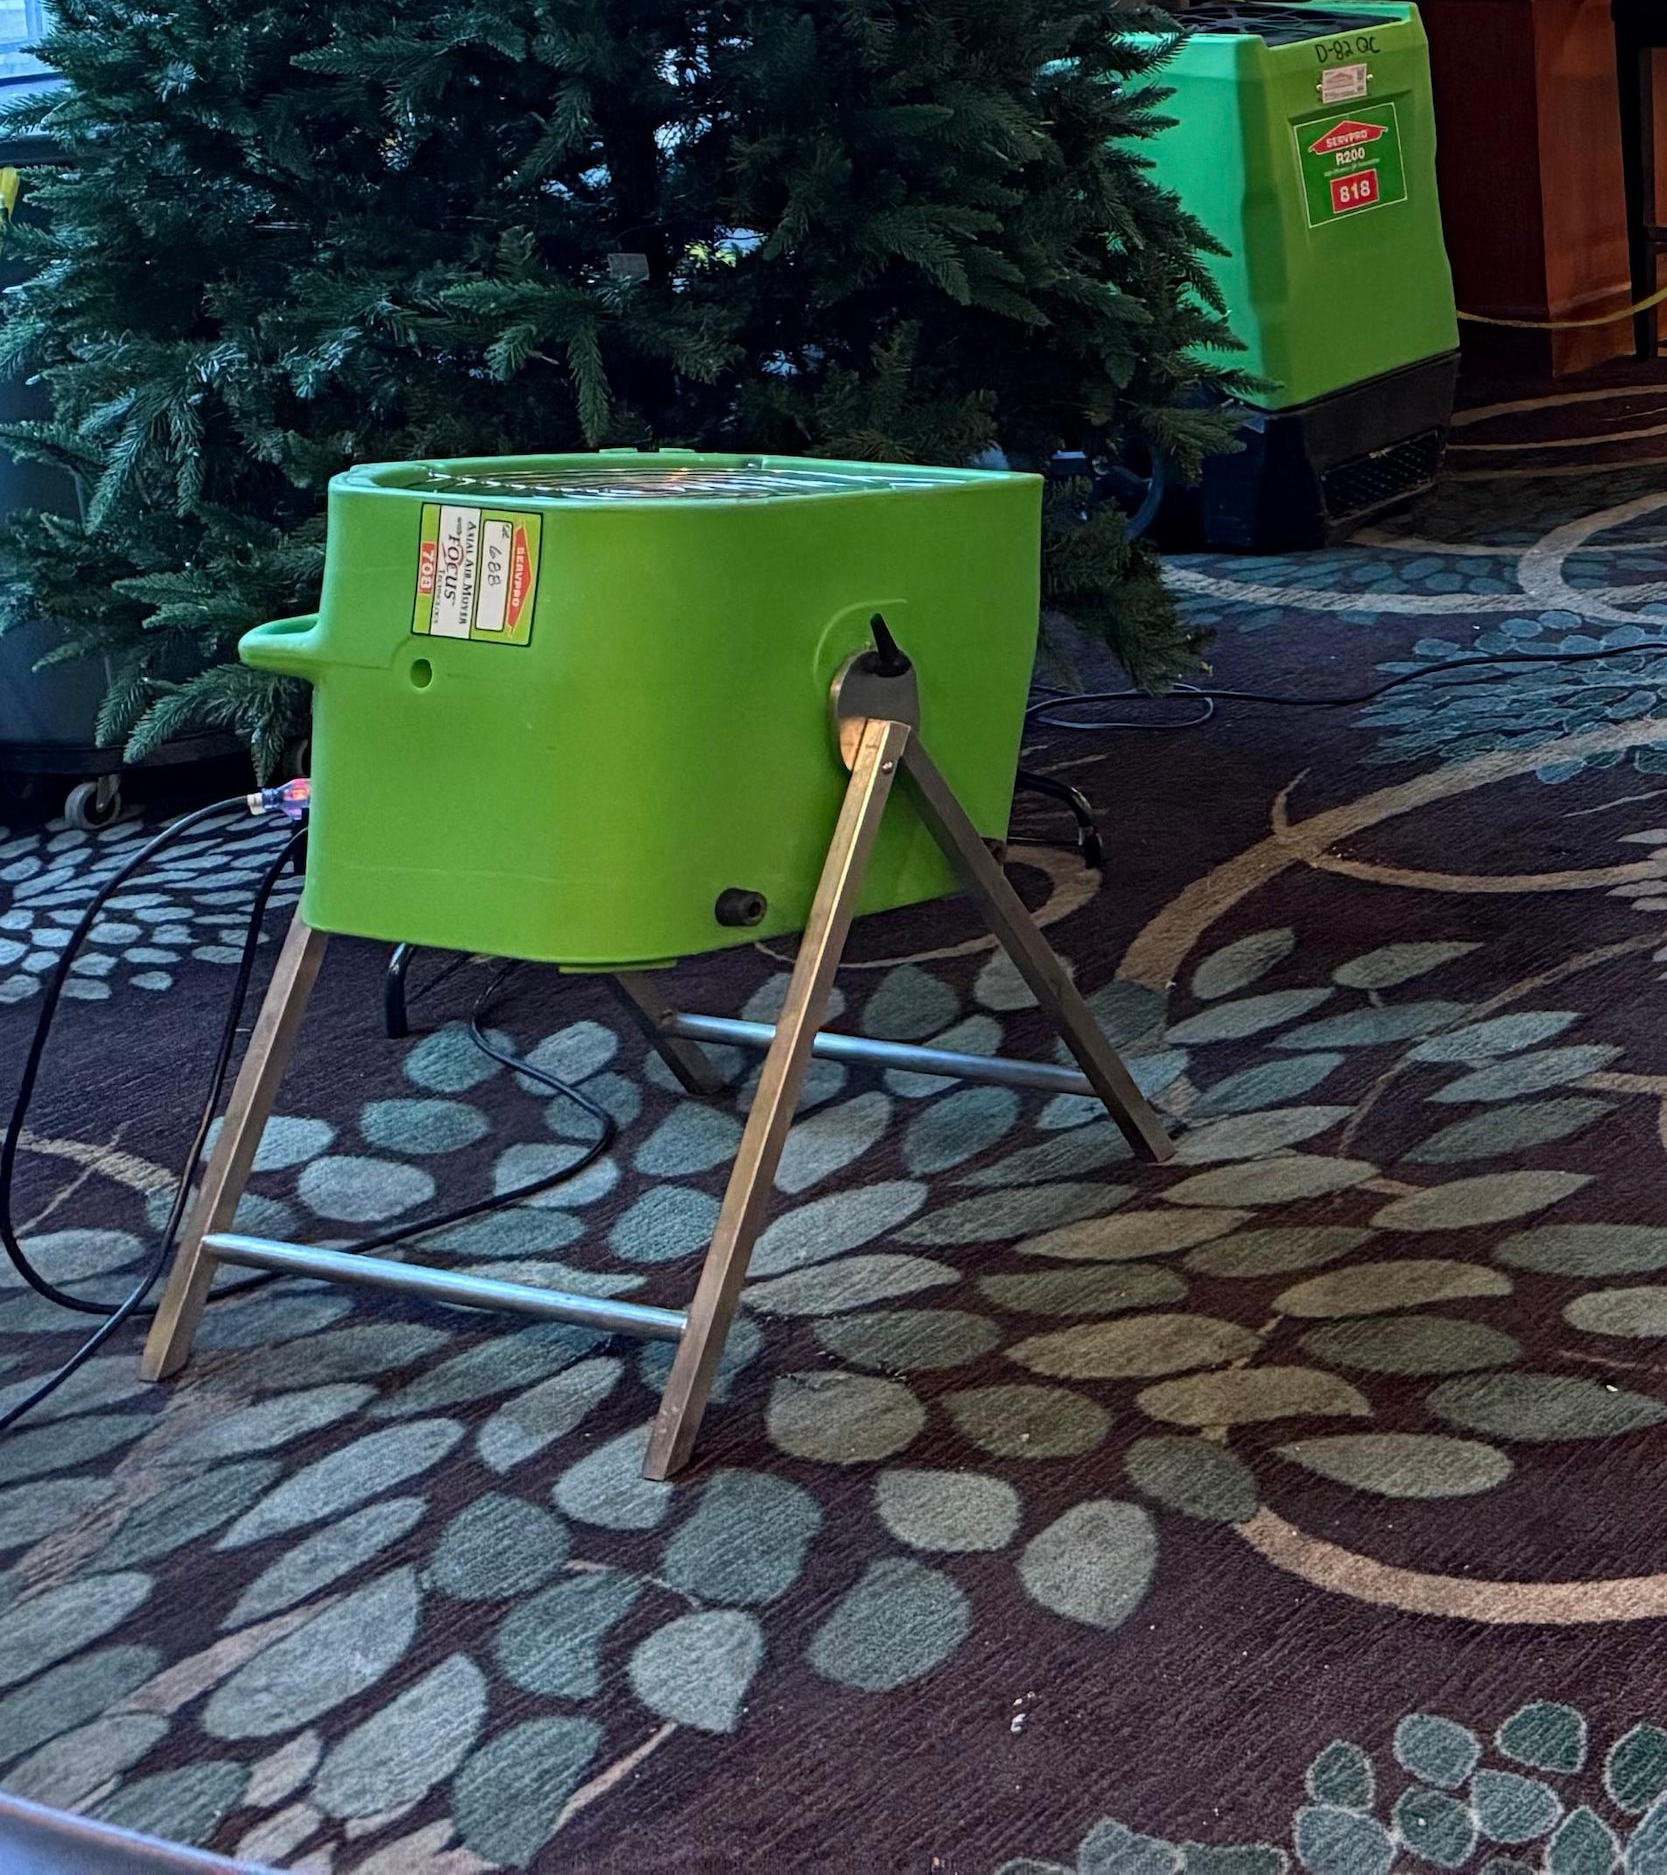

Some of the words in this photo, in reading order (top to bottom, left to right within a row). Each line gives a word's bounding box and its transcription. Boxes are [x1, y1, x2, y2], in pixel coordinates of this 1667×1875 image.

[1326, 129, 1368, 148] SERVPRO
[1336, 147, 1365, 166] R200
[1339, 180, 1371, 203] 818
[466, 521, 477, 555] AXIAL
[420, 550, 434, 589] 708
[444, 534, 461, 600] FOCUS
[464, 558, 474, 578] AIR
[487, 545, 502, 586] 688
[512, 546, 525, 607] SERVPRO
[459, 580, 472, 625] MOVER
